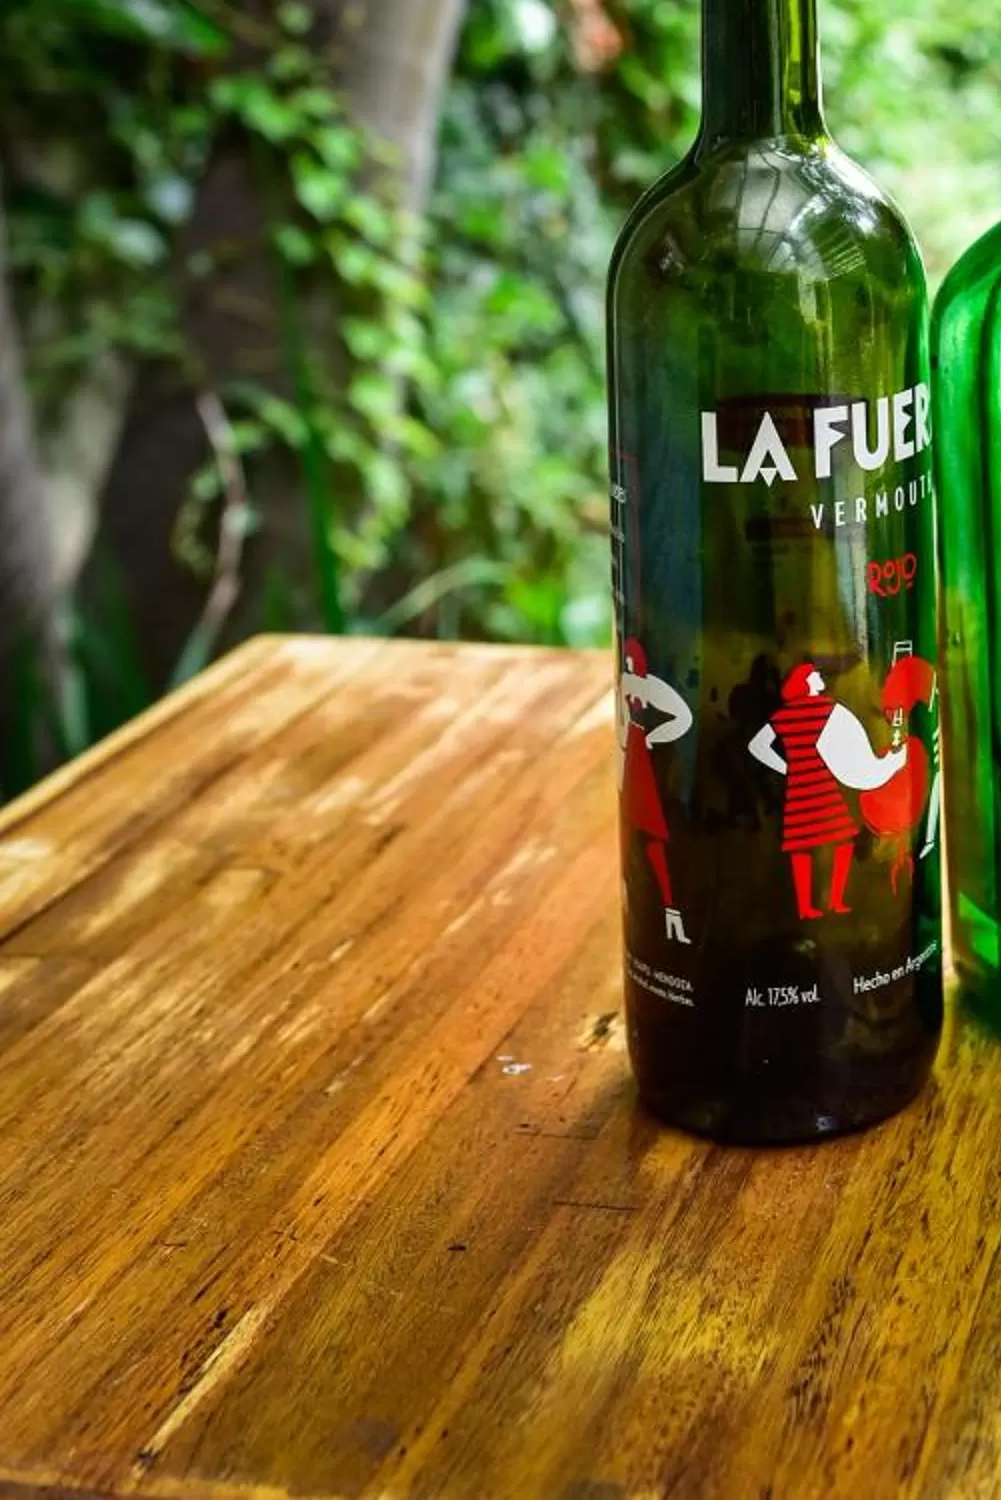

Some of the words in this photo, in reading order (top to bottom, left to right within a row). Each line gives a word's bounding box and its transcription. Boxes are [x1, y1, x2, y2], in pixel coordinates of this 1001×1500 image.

[701, 411, 798, 488] LA
[853, 970, 891, 995] Hecho
[891, 966, 905, 980] en
